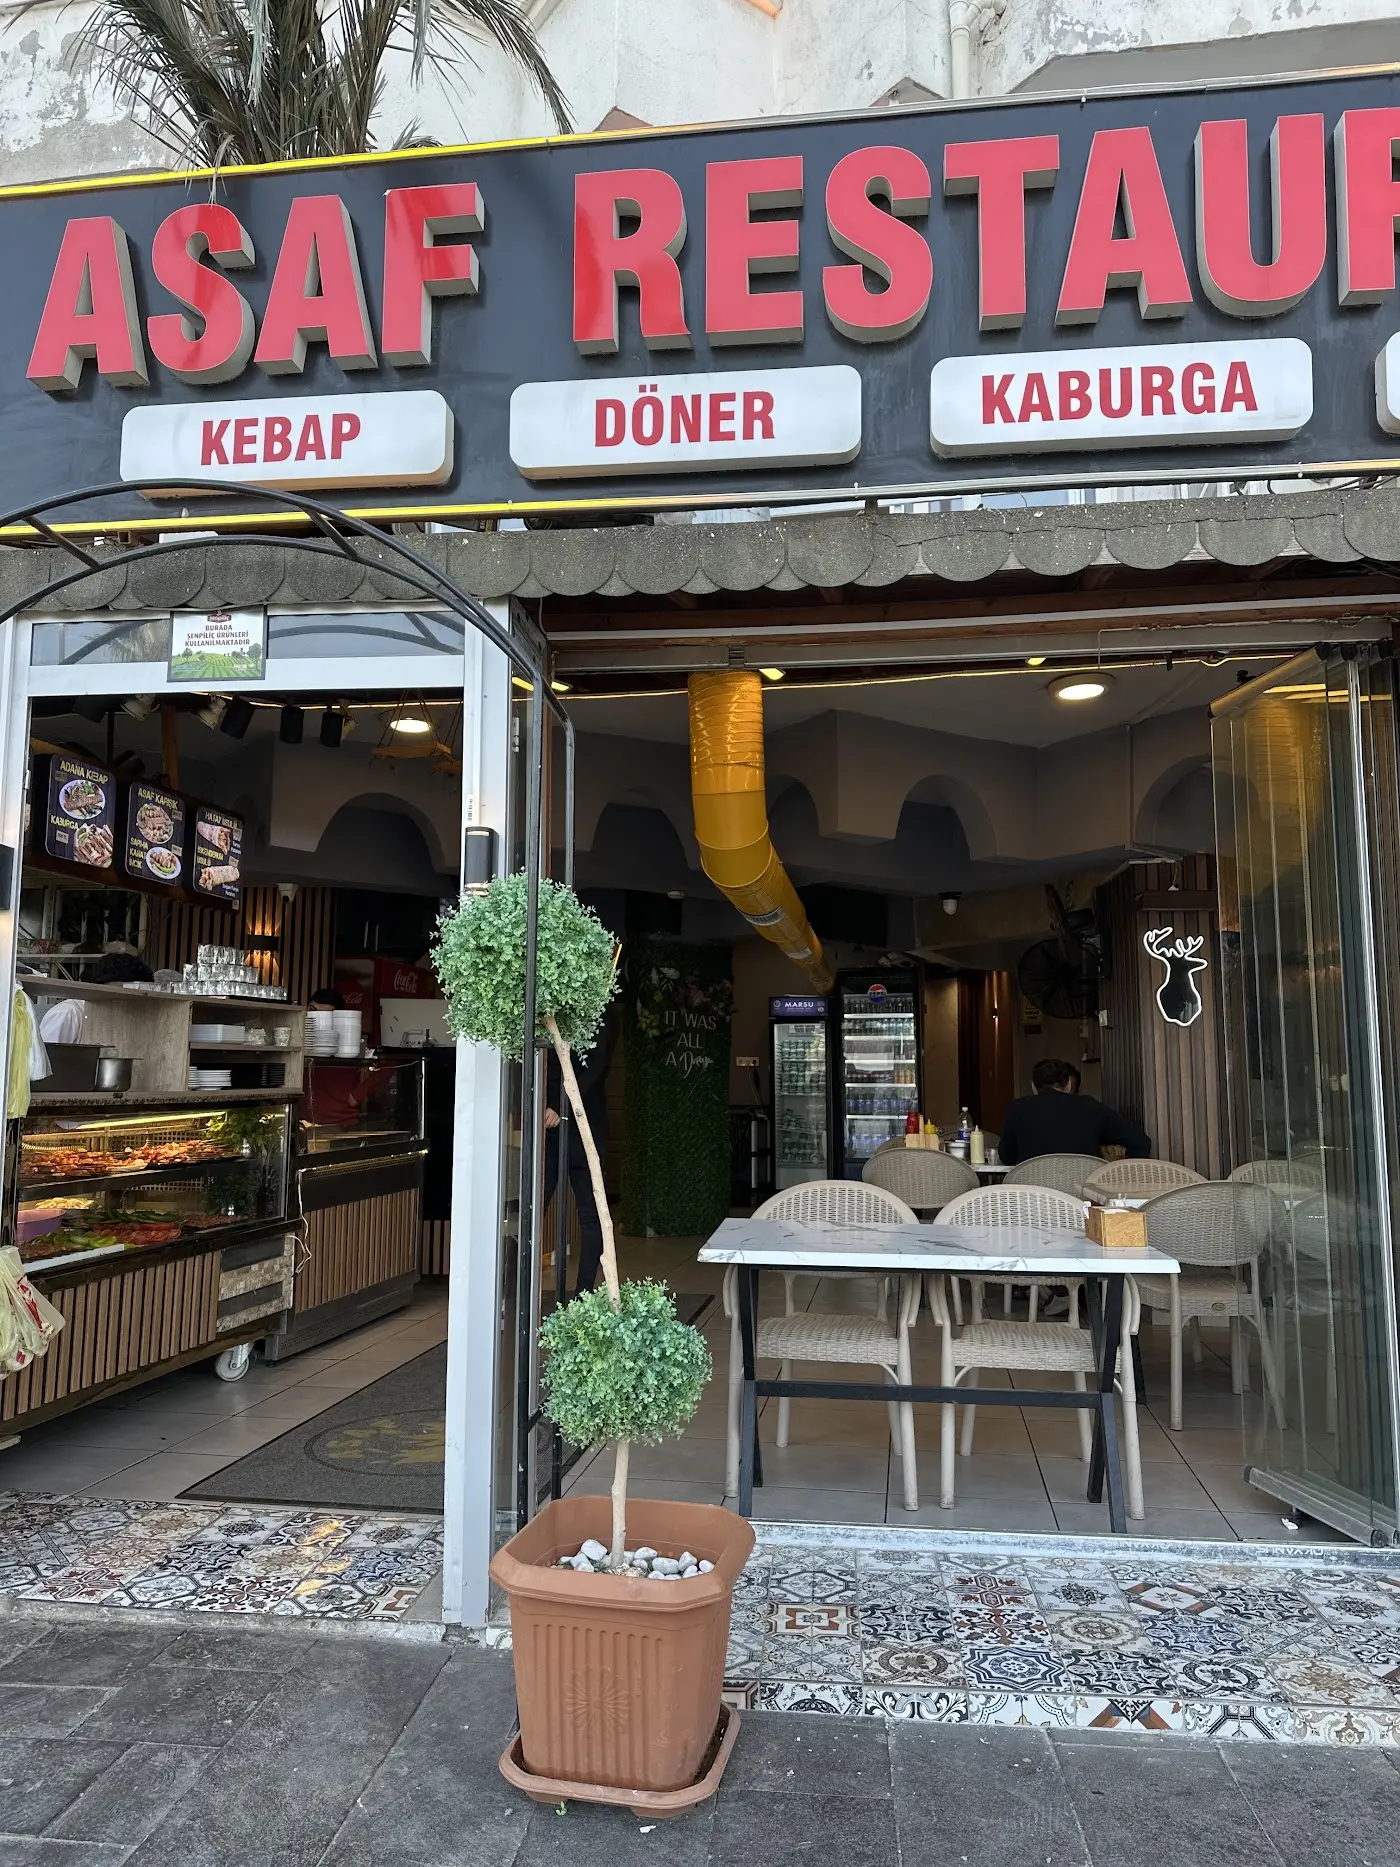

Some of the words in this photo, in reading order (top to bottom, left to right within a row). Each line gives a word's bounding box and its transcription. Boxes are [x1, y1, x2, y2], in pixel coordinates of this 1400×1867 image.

[27, 182, 483, 388] ASAF
[981, 361, 1259, 425] KABURGA
[594, 384, 775, 448] DÖNER
[200, 411, 361, 466] KEBAP
[186, 632, 215, 641] ŞENPİLİÇ
[216, 629, 249, 639] ÜRÜNLERİ
[205, 624, 233, 632] BURADA
[184, 638, 250, 647] KULLANILMAKTADIR
[60, 760, 85, 778] ADANA
[86, 769, 109, 785] KEBAP
[137, 787, 156, 801] ASAF
[50, 814, 79, 832] KABURGA
[664, 1010, 679, 1027] IT
[685, 1012, 717, 1030] WAS
[677, 1032, 704, 1049] ALL
[665, 1051, 677, 1068] A
